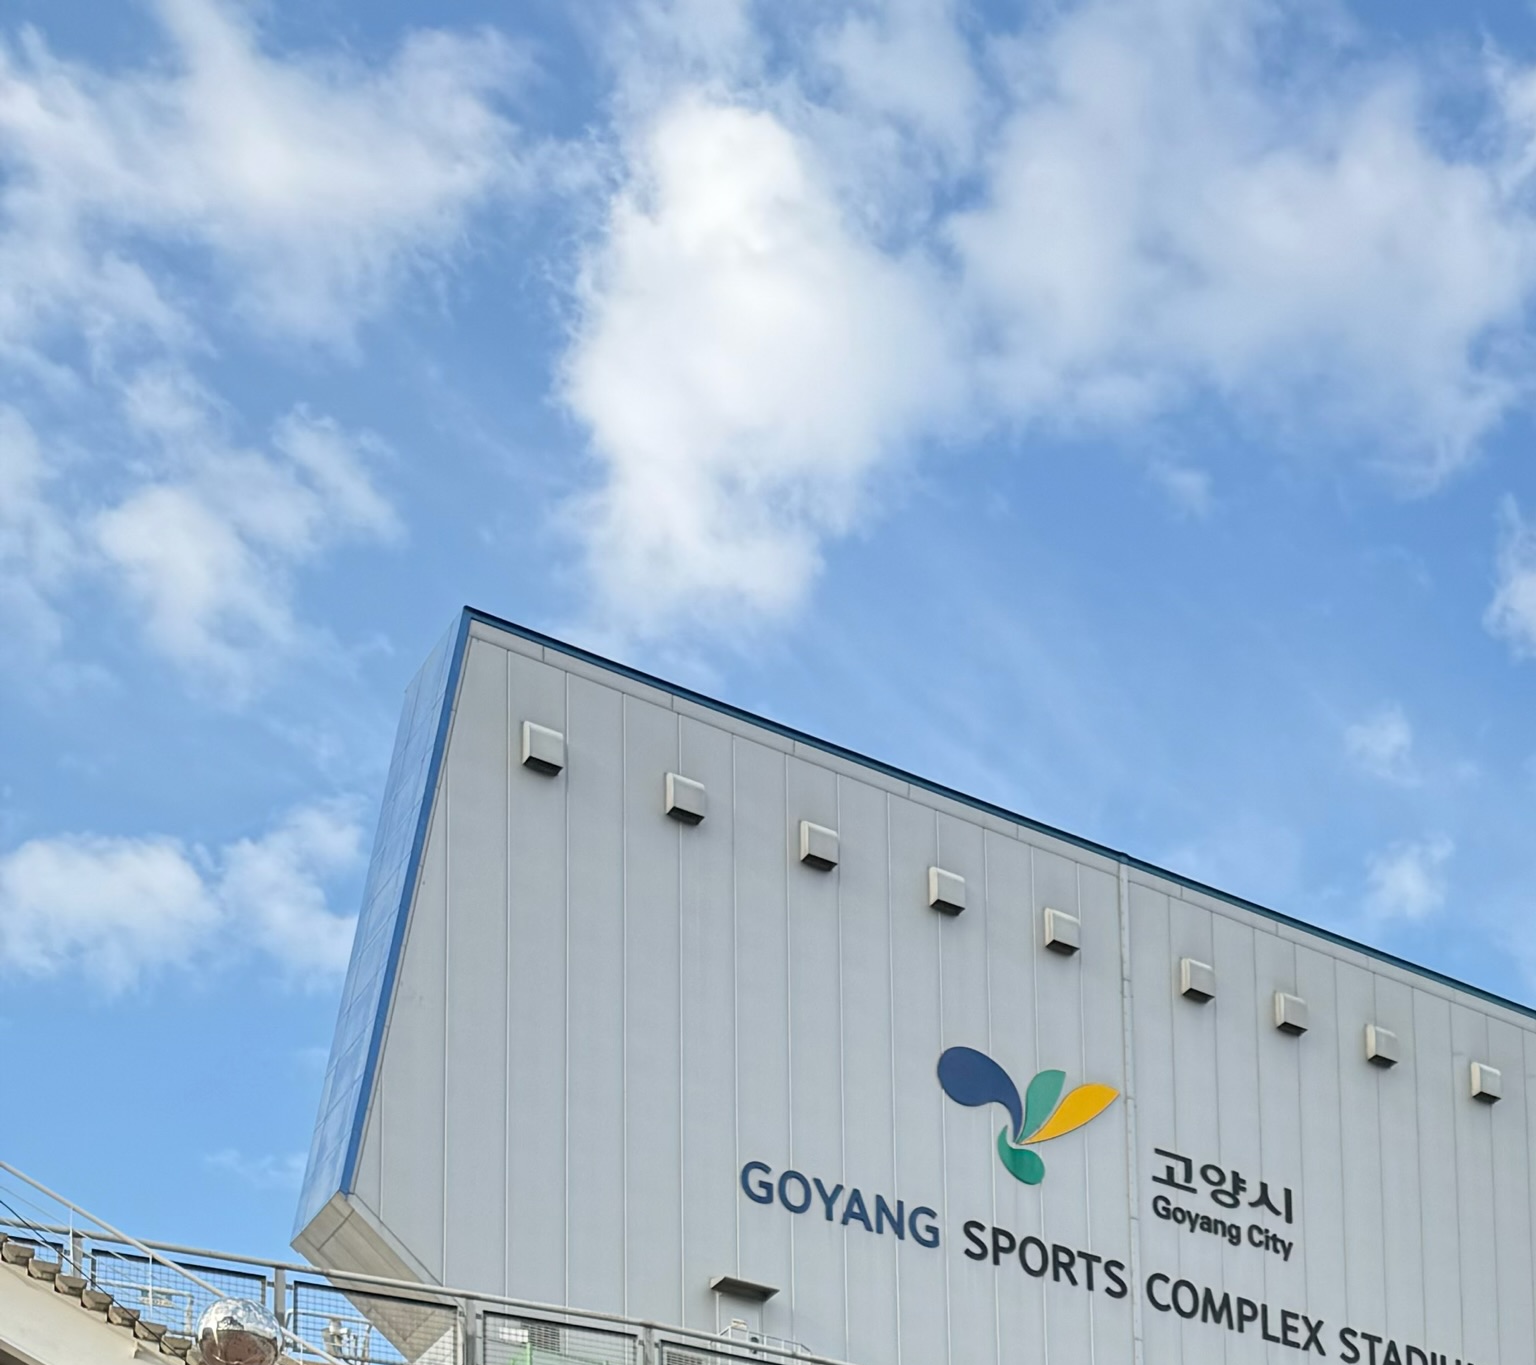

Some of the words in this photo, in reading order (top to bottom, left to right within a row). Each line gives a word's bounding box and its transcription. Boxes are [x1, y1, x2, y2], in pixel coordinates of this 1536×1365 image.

[1151, 1147, 1294, 1225] 고양시
[740, 1160, 941, 1250] GOYANG
[963, 1219, 1128, 1300] SPORTS
[1146, 1273, 1325, 1357] COMPLEX
[1151, 1194, 1242, 1248] Goyang
[1247, 1218, 1294, 1262] City
